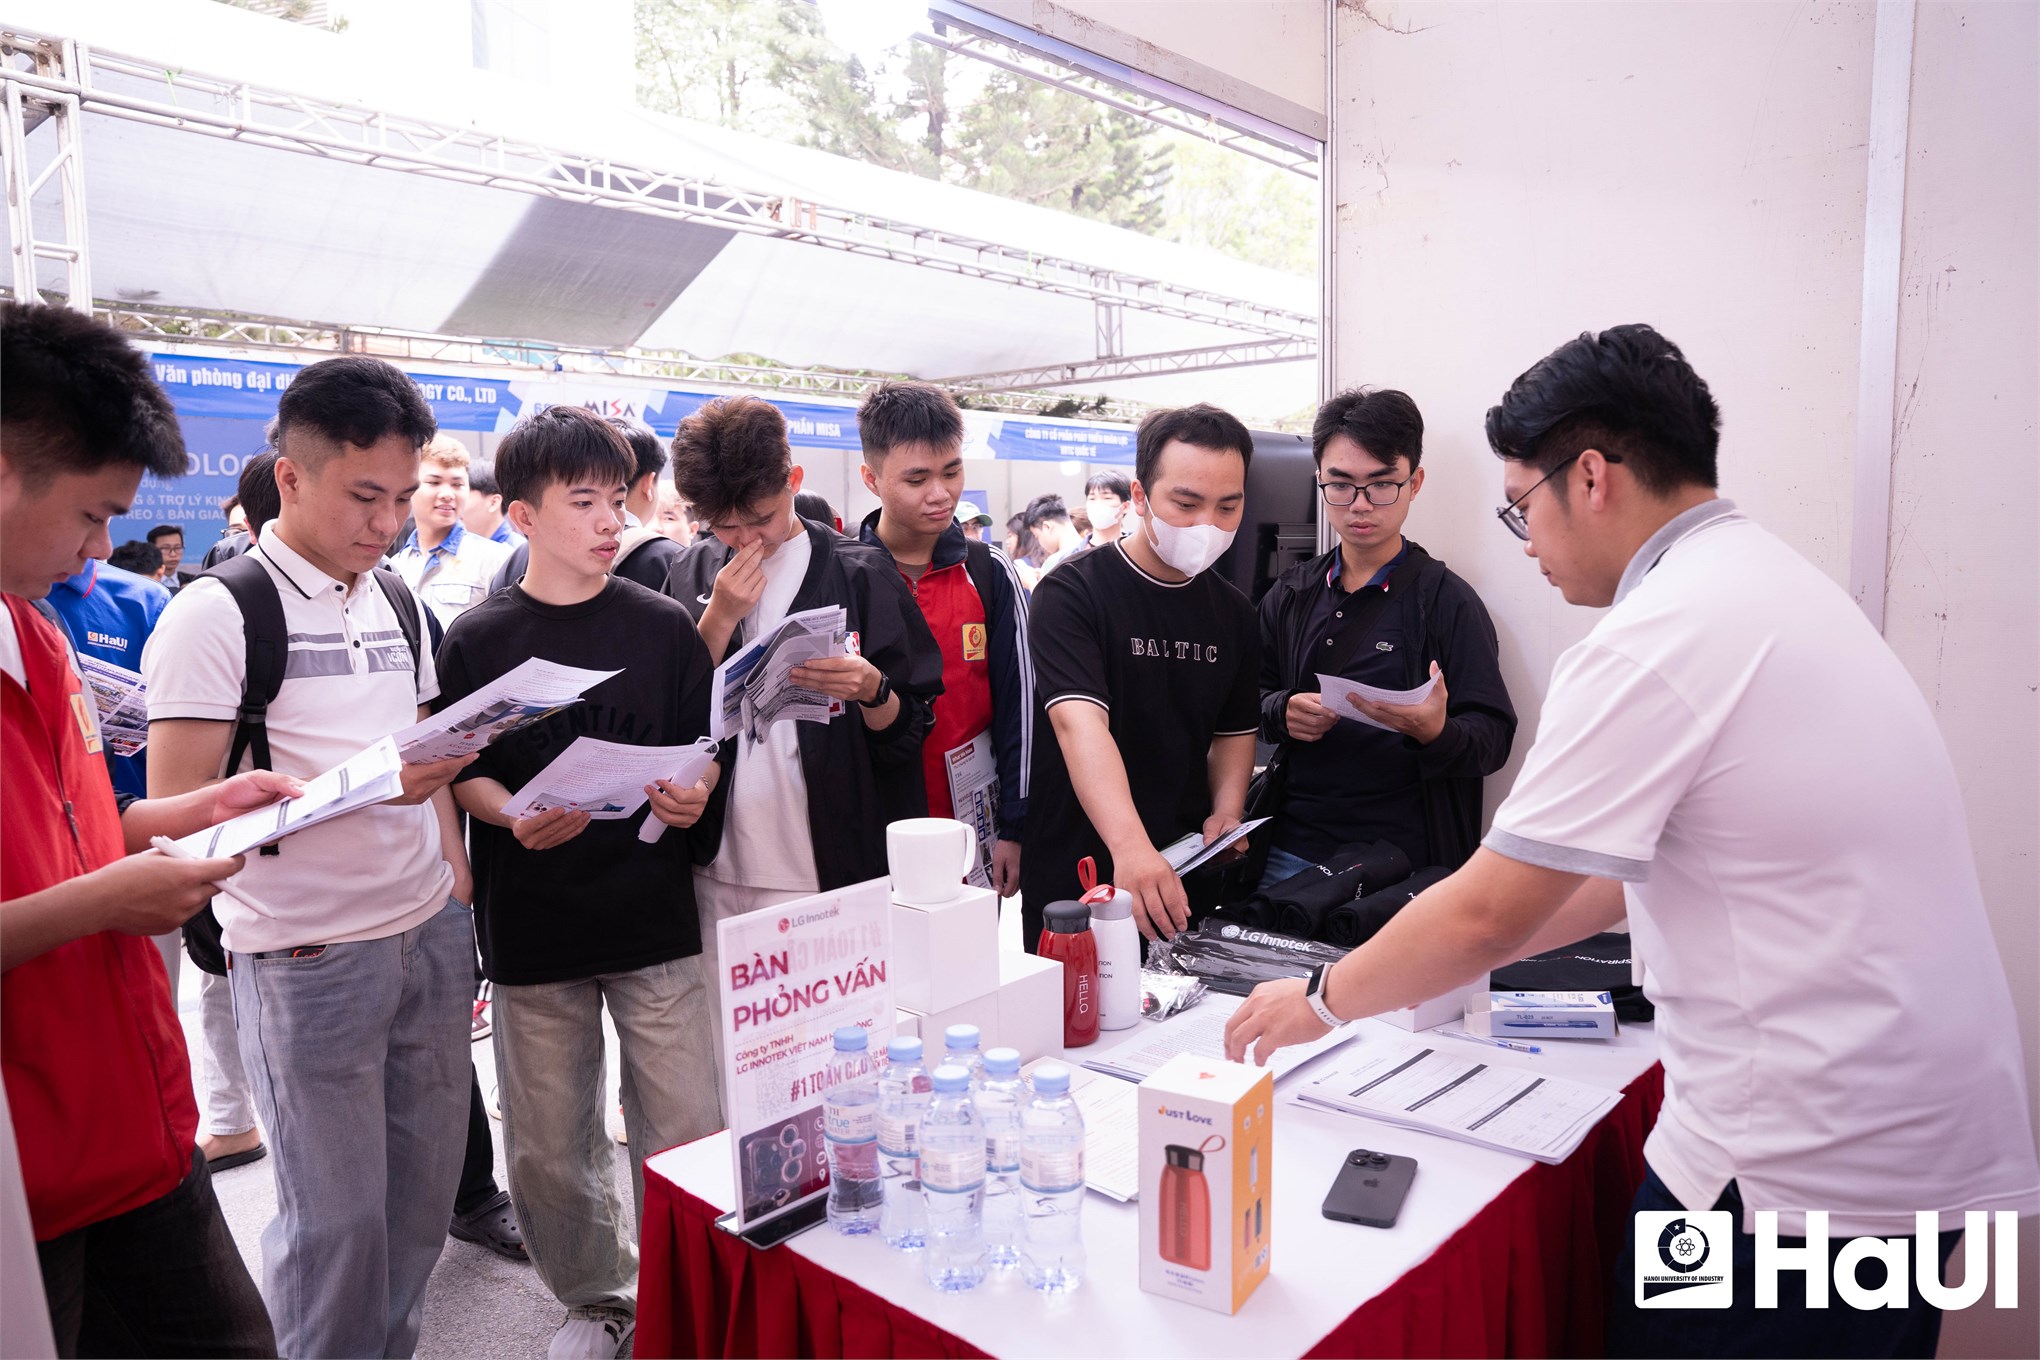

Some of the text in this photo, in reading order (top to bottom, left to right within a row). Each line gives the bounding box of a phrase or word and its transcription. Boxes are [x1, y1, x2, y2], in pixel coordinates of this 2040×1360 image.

[154, 364, 187, 384] Văn
[191, 367, 242, 389] phòng
[246, 370, 271, 392] đại
[447, 385, 472, 404] CO.,
[475, 387, 497, 404] LTD
[584, 398, 636, 417] MISA
[816, 422, 841, 437] MISA
[159, 494, 185, 508] TRỢ
[188, 492, 202, 506] LÝ
[1131, 637, 1217, 663] BALTIC
[791, 904, 840, 928] LG Innotek
[1240, 929, 1312, 952] LG Innotek
[730, 951, 789, 991] BÀN
[733, 956, 886, 1032] PHỎNG VẤN
[1079, 974, 1089, 1014] HELLO
[735, 1035, 794, 1063] Công ty TNHH
[736, 1062, 748, 1075] LG
[750, 1051, 788, 1070] INNOTEK
[808, 1036, 828, 1048] NAM
[791, 1076, 807, 1102] #1
[828, 1115, 850, 1128] true
